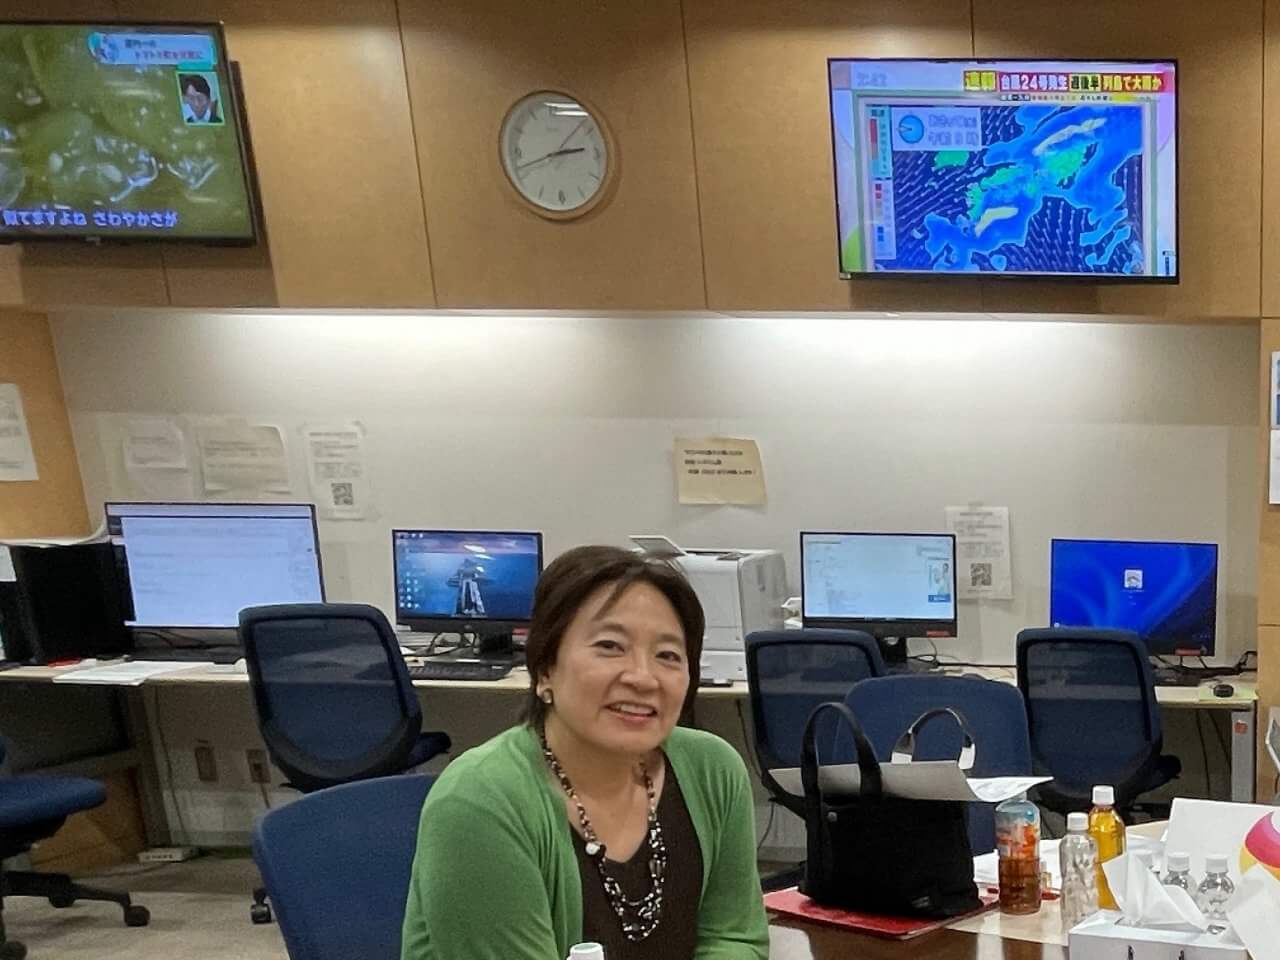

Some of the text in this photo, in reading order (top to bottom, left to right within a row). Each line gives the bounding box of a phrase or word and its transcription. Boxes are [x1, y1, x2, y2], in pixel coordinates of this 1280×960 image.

[93, 210, 179, 228] さわやかさが
